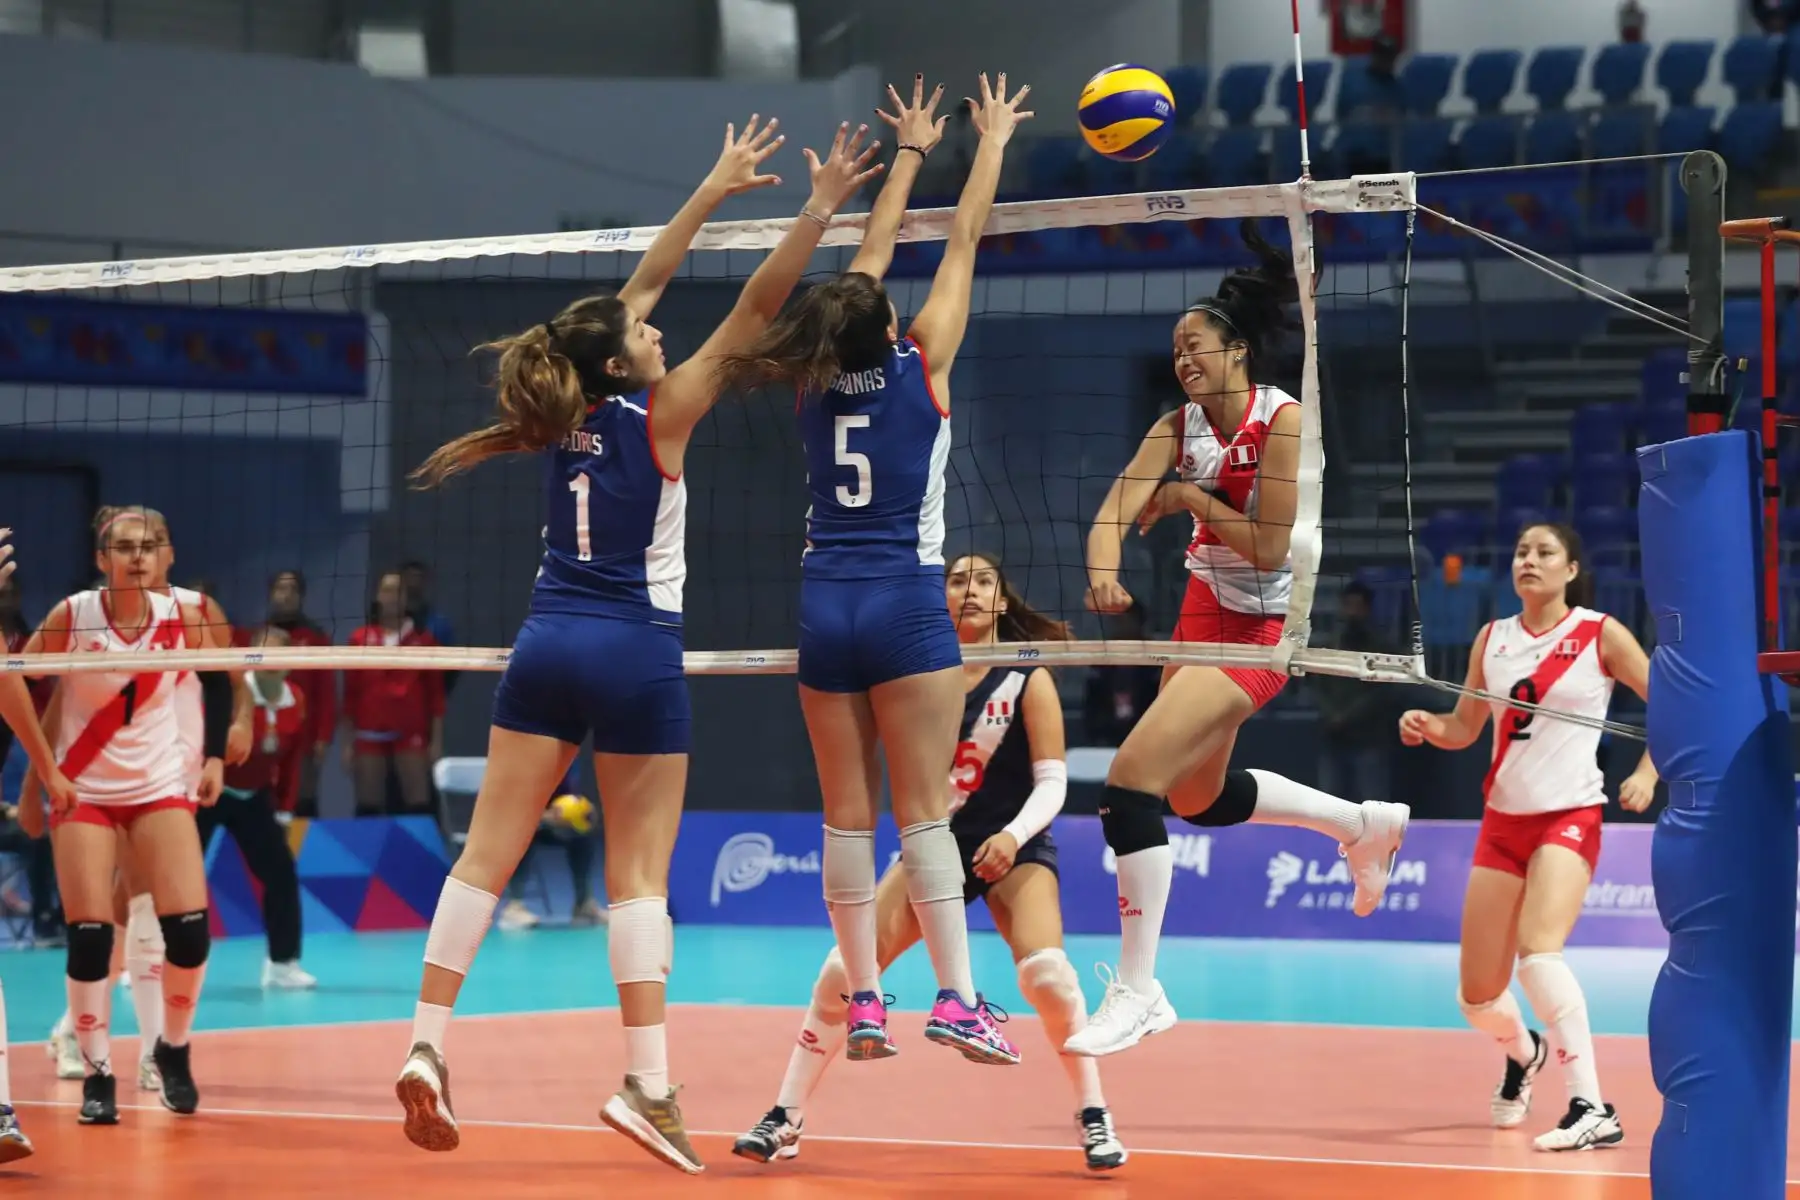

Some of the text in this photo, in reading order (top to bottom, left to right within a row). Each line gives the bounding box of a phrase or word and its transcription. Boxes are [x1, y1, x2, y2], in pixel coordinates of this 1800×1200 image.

[1145, 195, 1186, 211] FIVB
[1365, 179, 1400, 187] Senoh
[835, 414, 872, 508] 5
[568, 471, 592, 561] 1
[120, 679, 137, 727] 1
[986, 716, 1011, 726] PER
[1509, 678, 1538, 731] 9
[955, 741, 984, 792] 5
[1305, 859, 1427, 886] LAM
